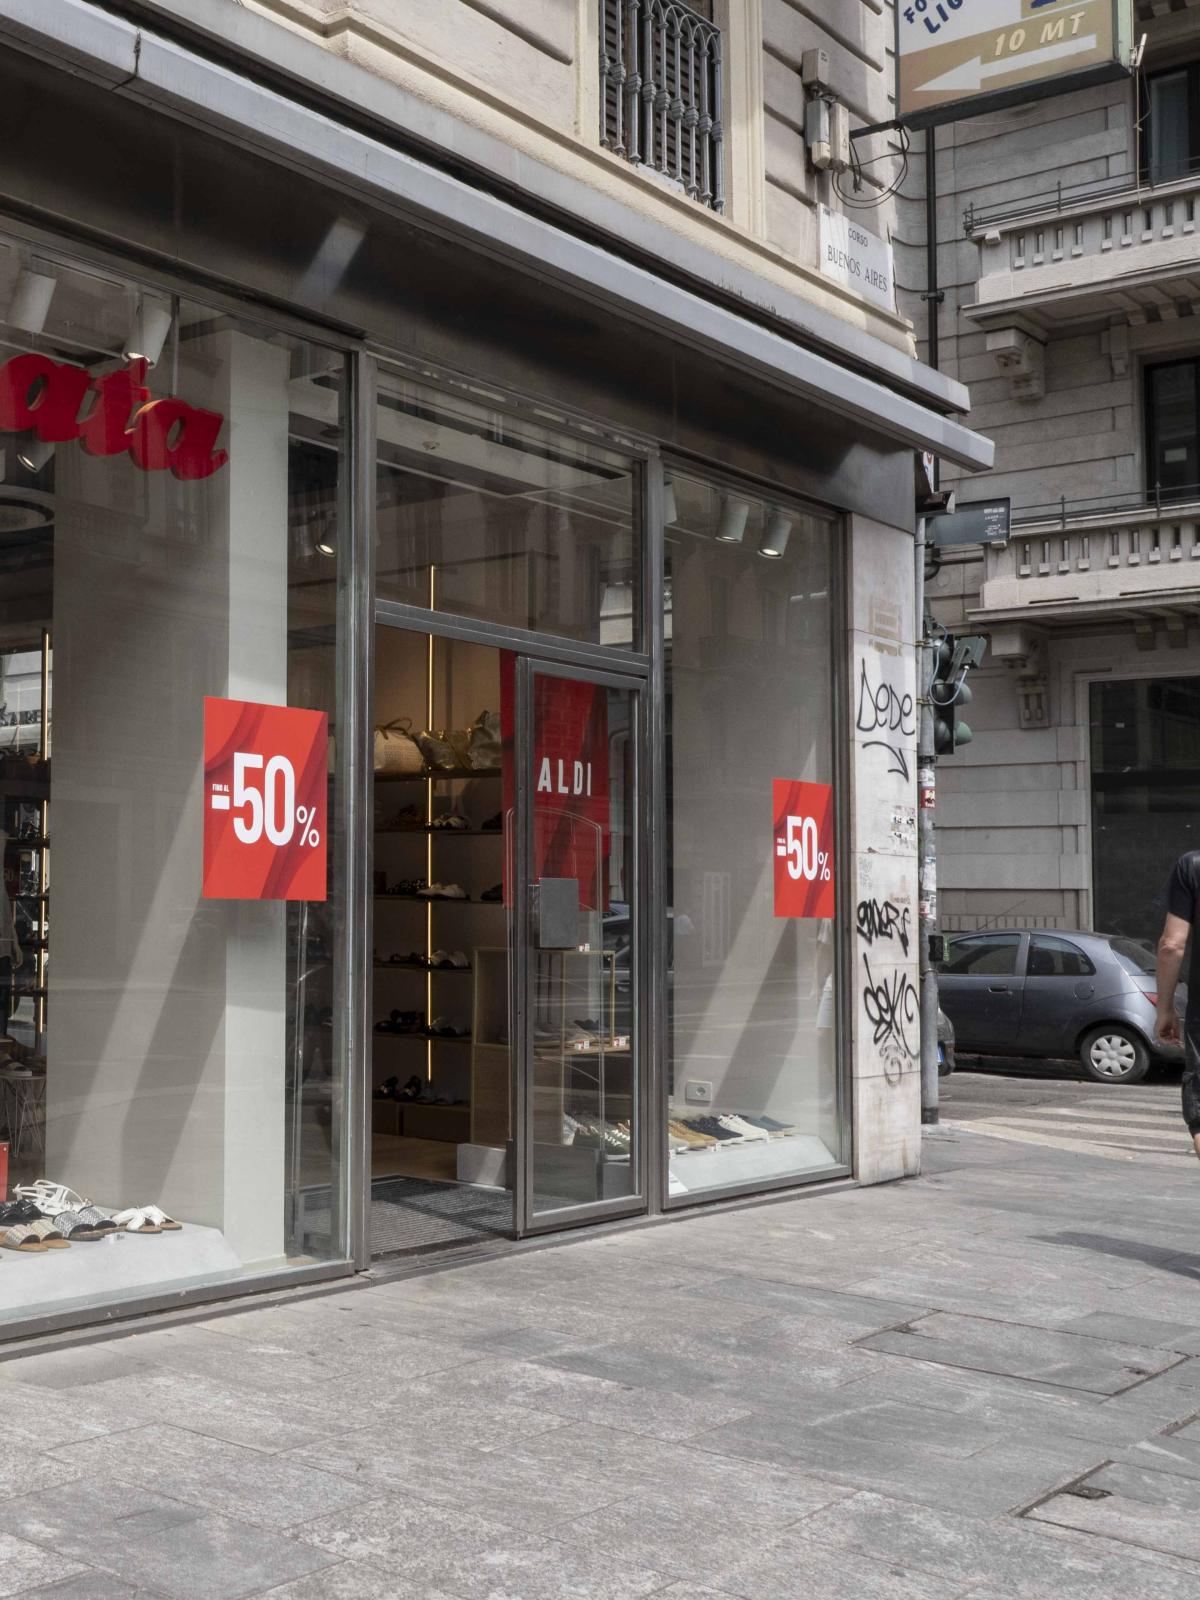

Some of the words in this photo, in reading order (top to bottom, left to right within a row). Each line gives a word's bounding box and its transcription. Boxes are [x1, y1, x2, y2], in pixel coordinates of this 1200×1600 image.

[995, 28, 1026, 56] 10
[1039, 11, 1086, 44] MT
[848, 227, 868, 248] CORSO
[827, 244, 860, 277] BUENOS
[864, 267, 888, 293] AIRES
[537, 757, 592, 797] ALDI
